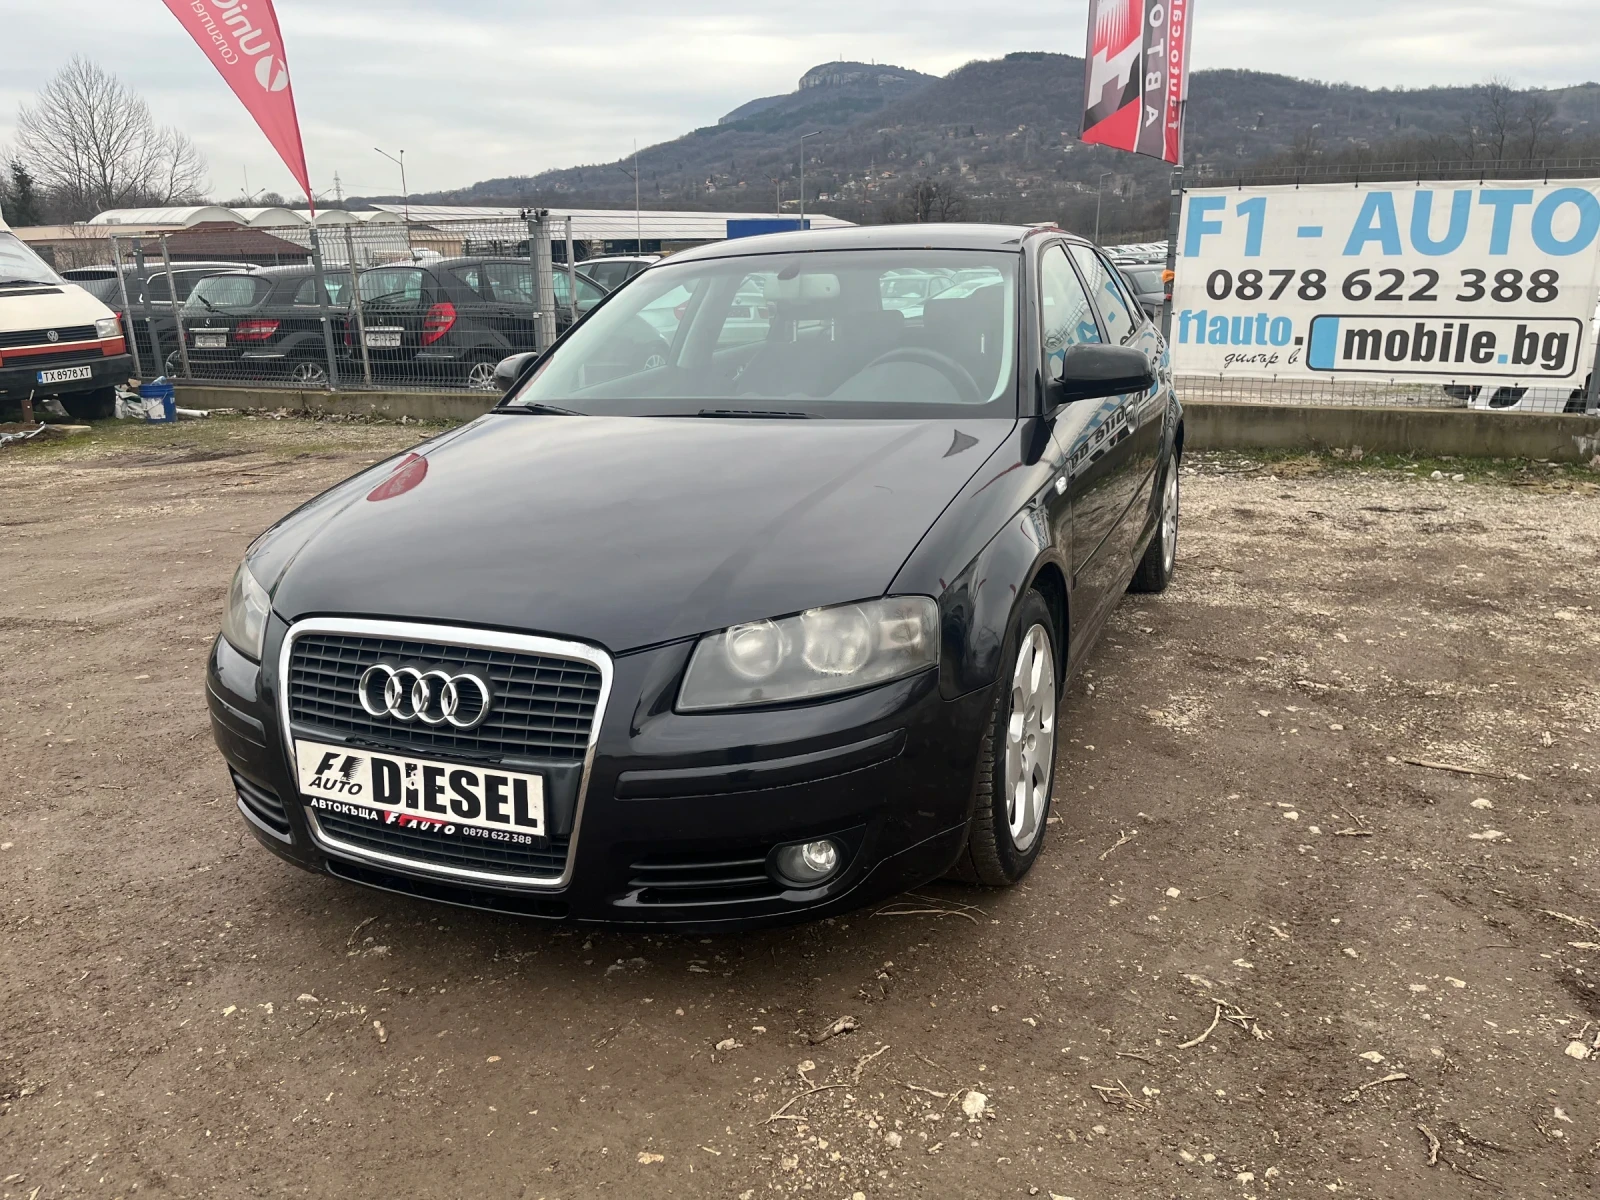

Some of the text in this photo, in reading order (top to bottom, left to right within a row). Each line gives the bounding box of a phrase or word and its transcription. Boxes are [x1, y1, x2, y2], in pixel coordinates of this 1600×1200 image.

[1184, 196, 1267, 257] F1
[1342, 187, 1600, 256] AUTO
[1206, 268, 1560, 303] 0878 622 388
[1342, 322, 1570, 371] mobile.bg
[308, 776, 363, 795] AUTO
[310, 797, 379, 821] АВТОКЪЩА
[407, 819, 456, 835] AUTO
[463, 826, 489, 838] 0878
[491, 831, 510, 842] 622
[511, 834, 532, 845] 388
